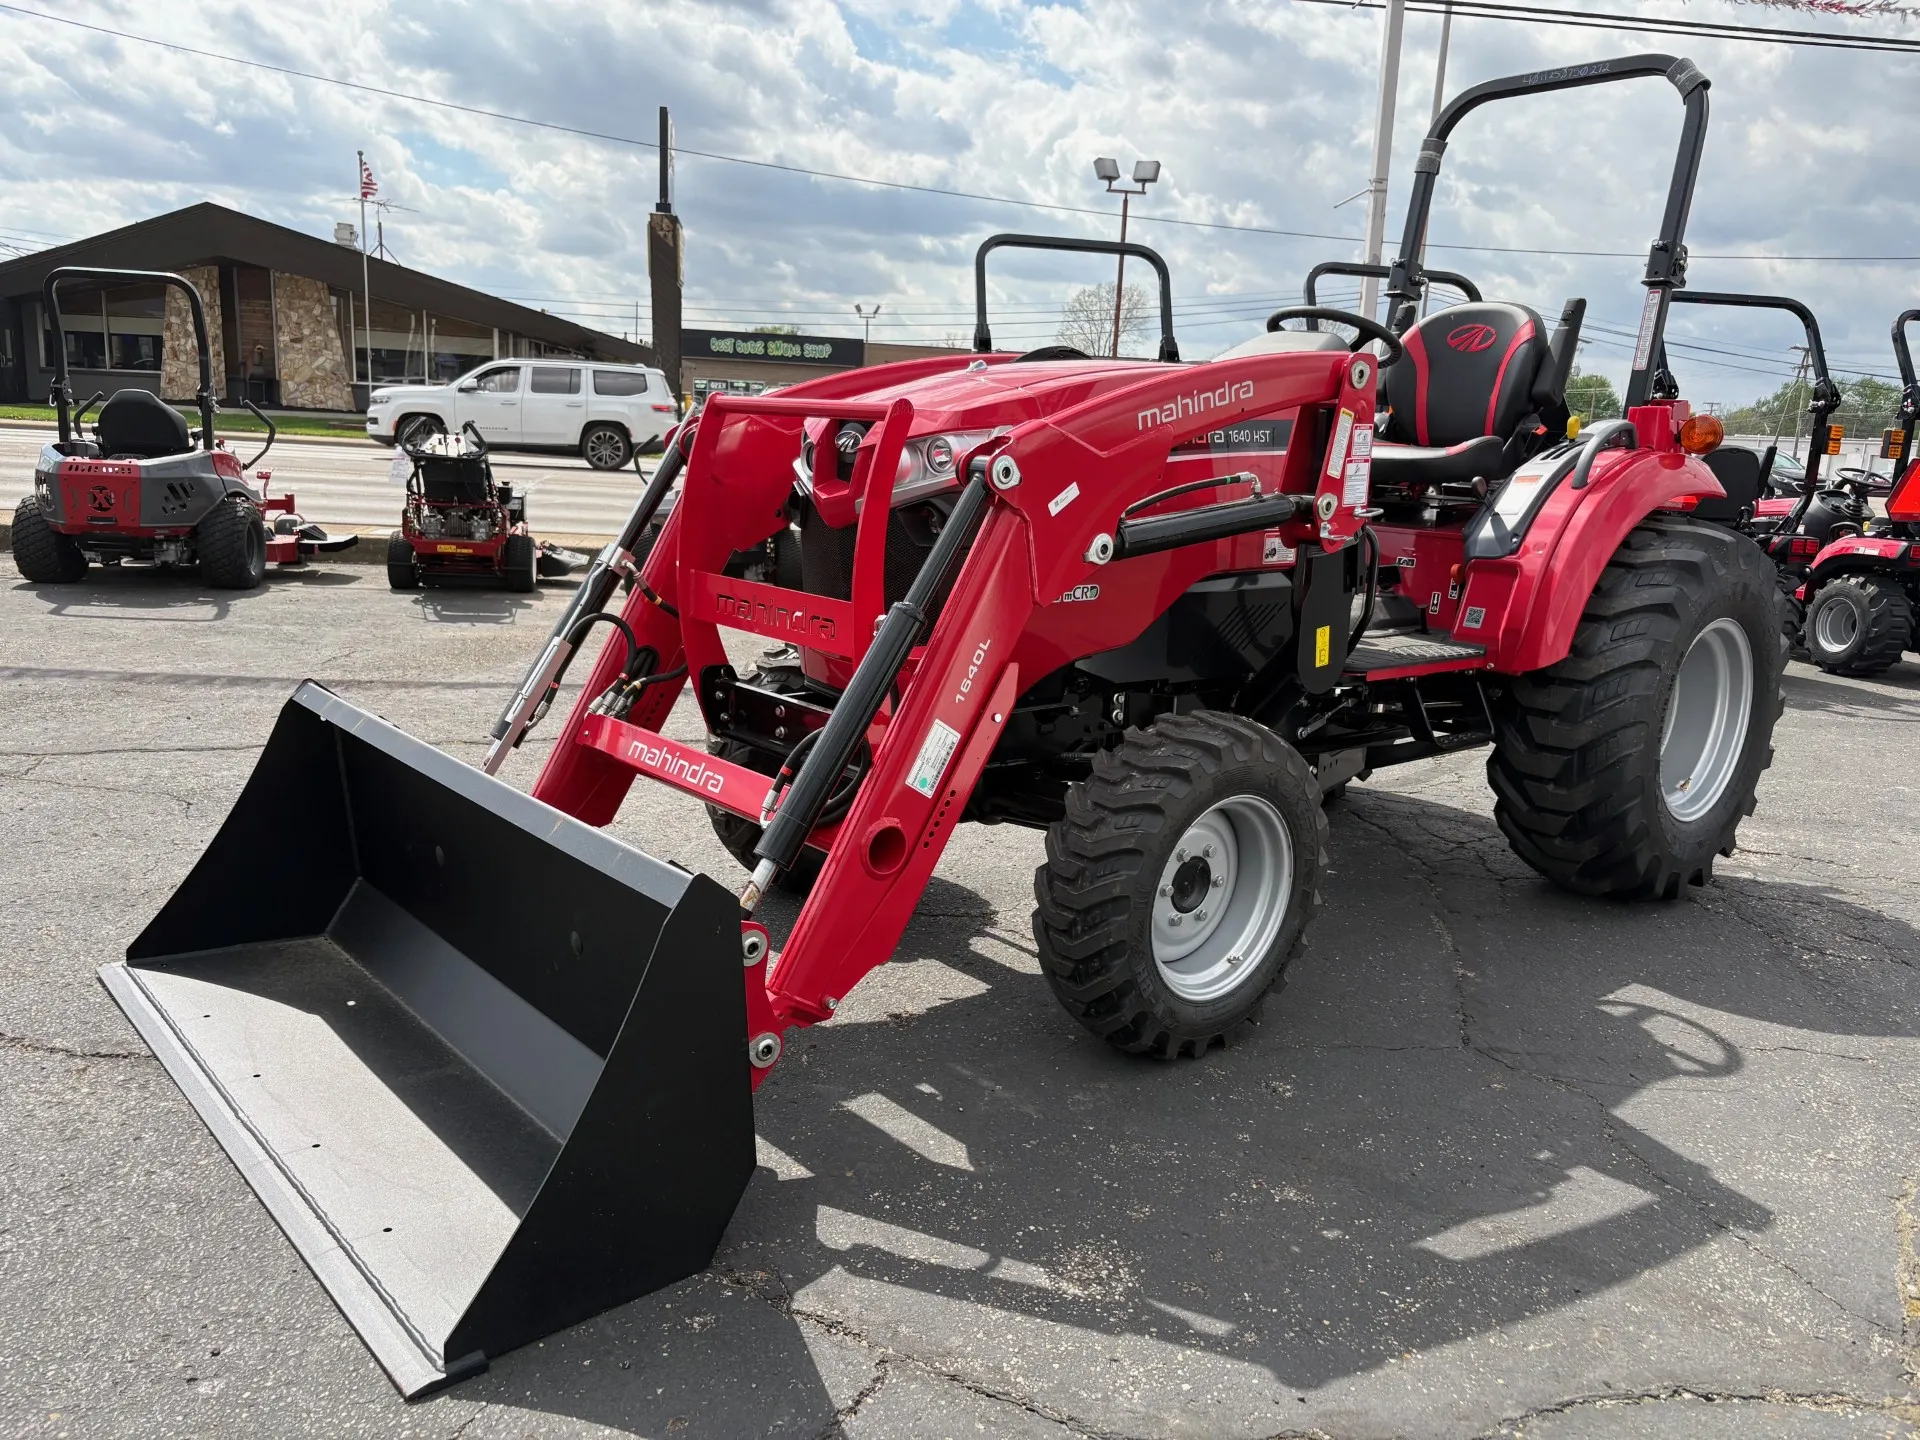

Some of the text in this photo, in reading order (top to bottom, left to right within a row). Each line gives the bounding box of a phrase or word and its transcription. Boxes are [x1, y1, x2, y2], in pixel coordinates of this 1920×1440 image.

[803, 343, 832, 358] SHOP
[1138, 380, 1254, 431] mahindra
[1229, 430, 1251, 443] 1640
[1253, 430, 1270, 443] HST
[717, 593, 836, 640] mahindra
[955, 639, 991, 703] 1640L
[628, 740, 724, 793] mahindra
